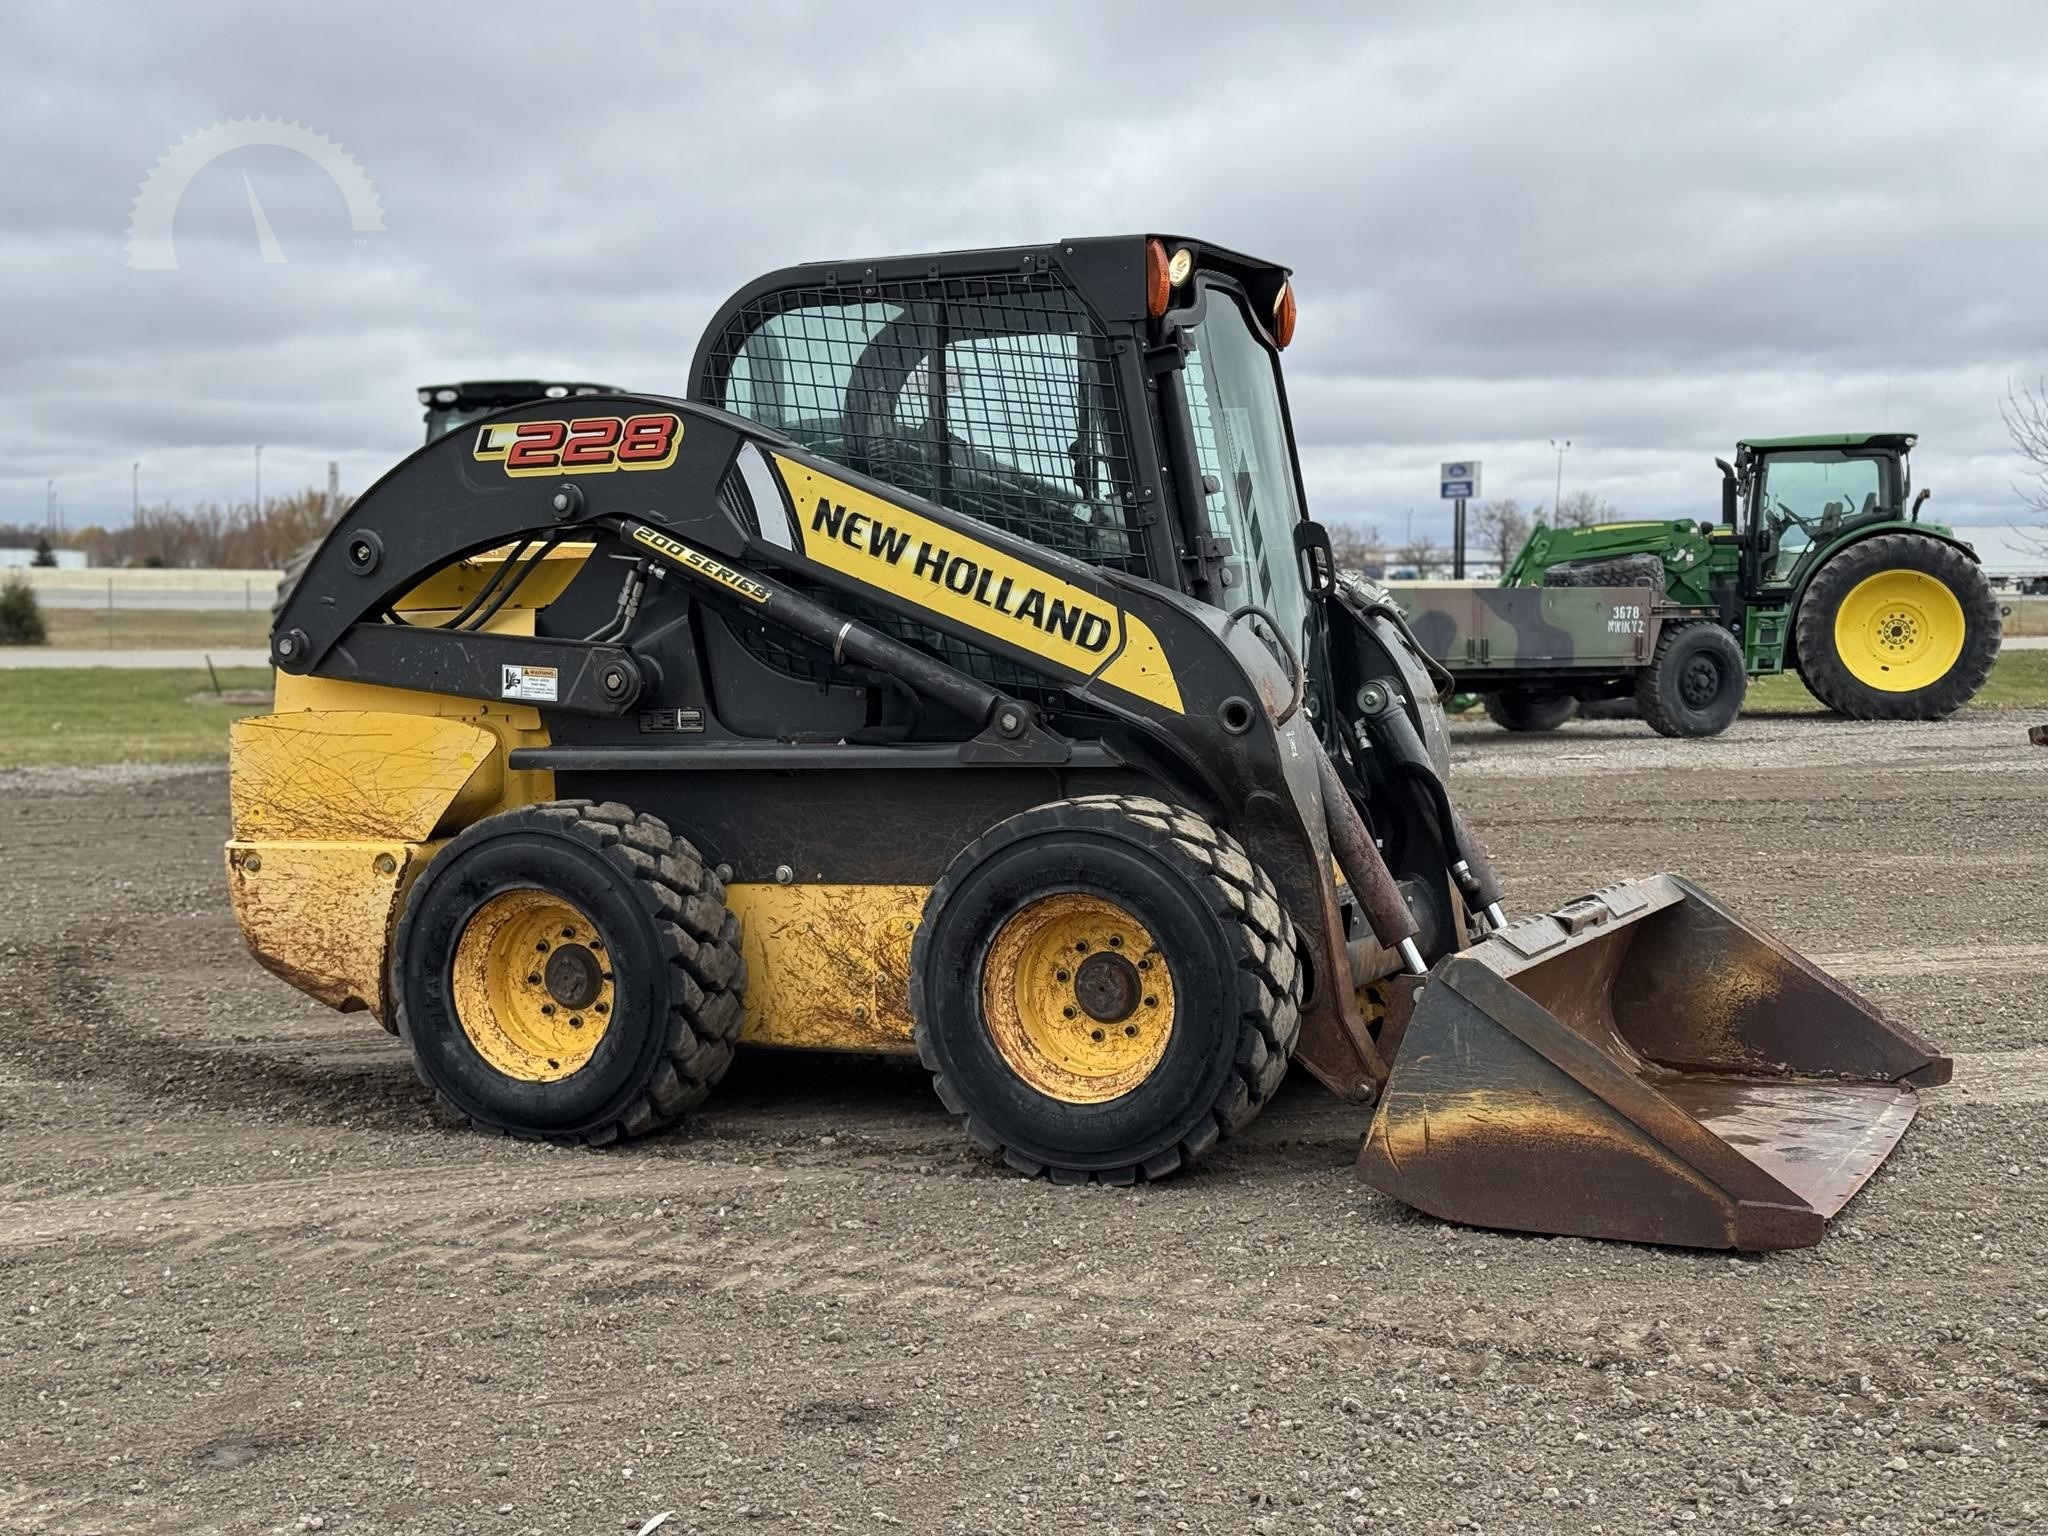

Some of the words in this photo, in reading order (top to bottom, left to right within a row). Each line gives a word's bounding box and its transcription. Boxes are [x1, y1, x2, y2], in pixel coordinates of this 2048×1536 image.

[477, 415, 680, 471] L228
[635, 527, 686, 557] 200
[685, 553, 769, 600] SERIES
[810, 496, 912, 566] NEW
[912, 541, 1112, 654] HOLLAND
[1613, 606, 1640, 619] 3678
